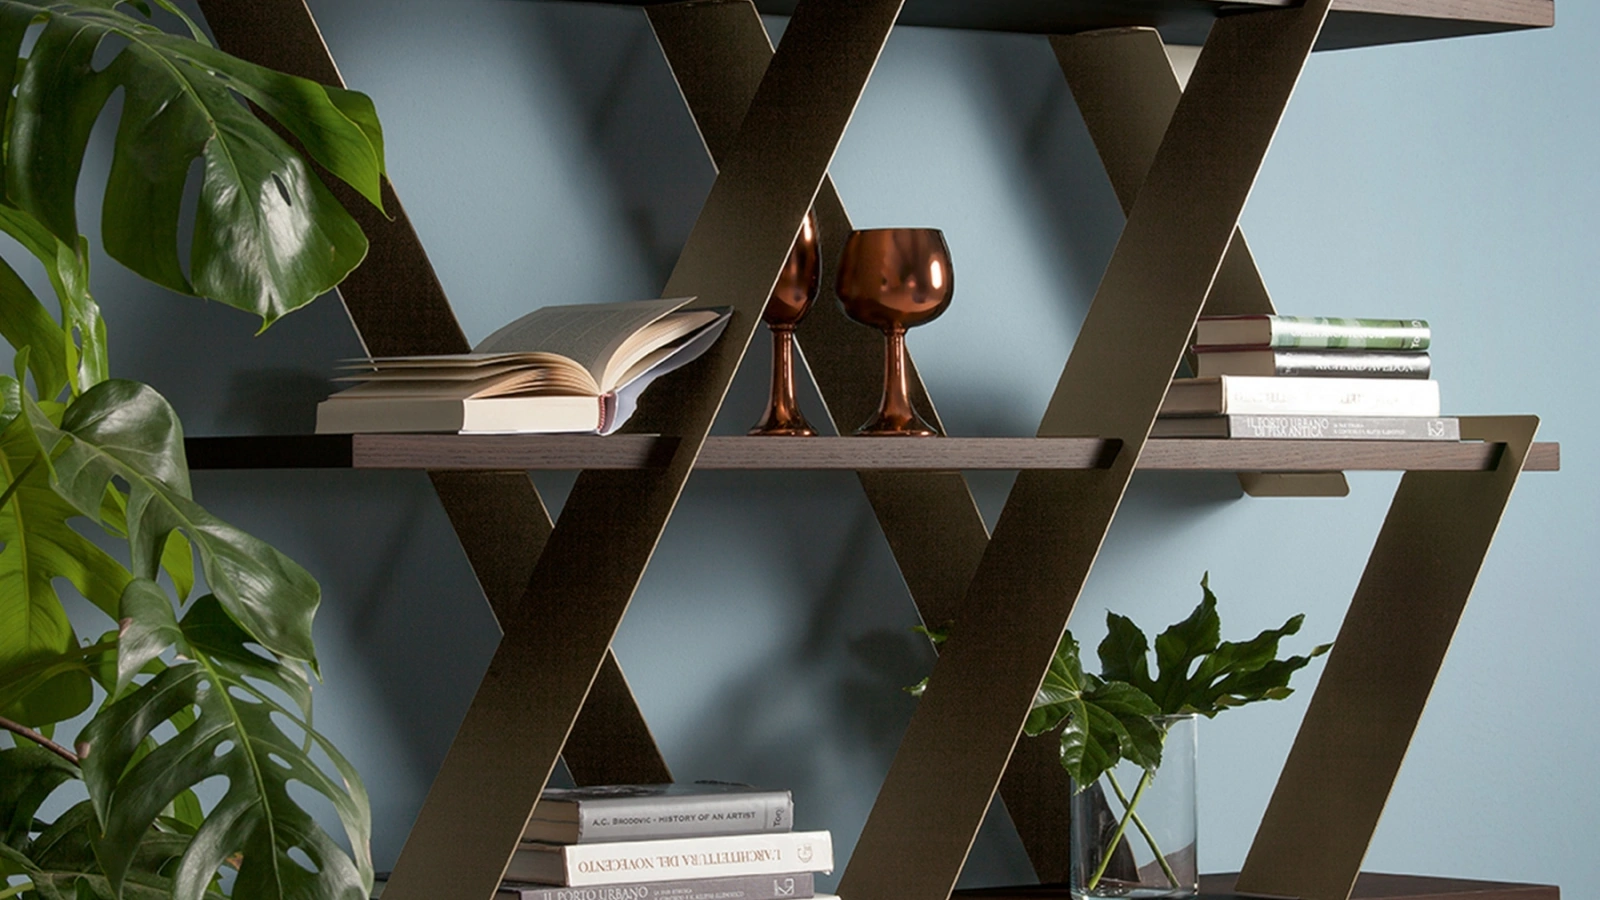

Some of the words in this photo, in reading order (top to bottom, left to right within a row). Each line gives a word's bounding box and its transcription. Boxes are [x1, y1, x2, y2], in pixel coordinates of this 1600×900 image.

[659, 813, 696, 823] HISTORY
[697, 813, 710, 821] OF
[711, 812, 724, 820] AN
[726, 811, 756, 820] ARTIST
[656, 855, 679, 868] DEL
[682, 849, 782, 866] L'ARCHITETTURA
[577, 857, 655, 873] NOVECENTO
[557, 889, 596, 900] PORTO
[598, 886, 648, 900] URBANO
